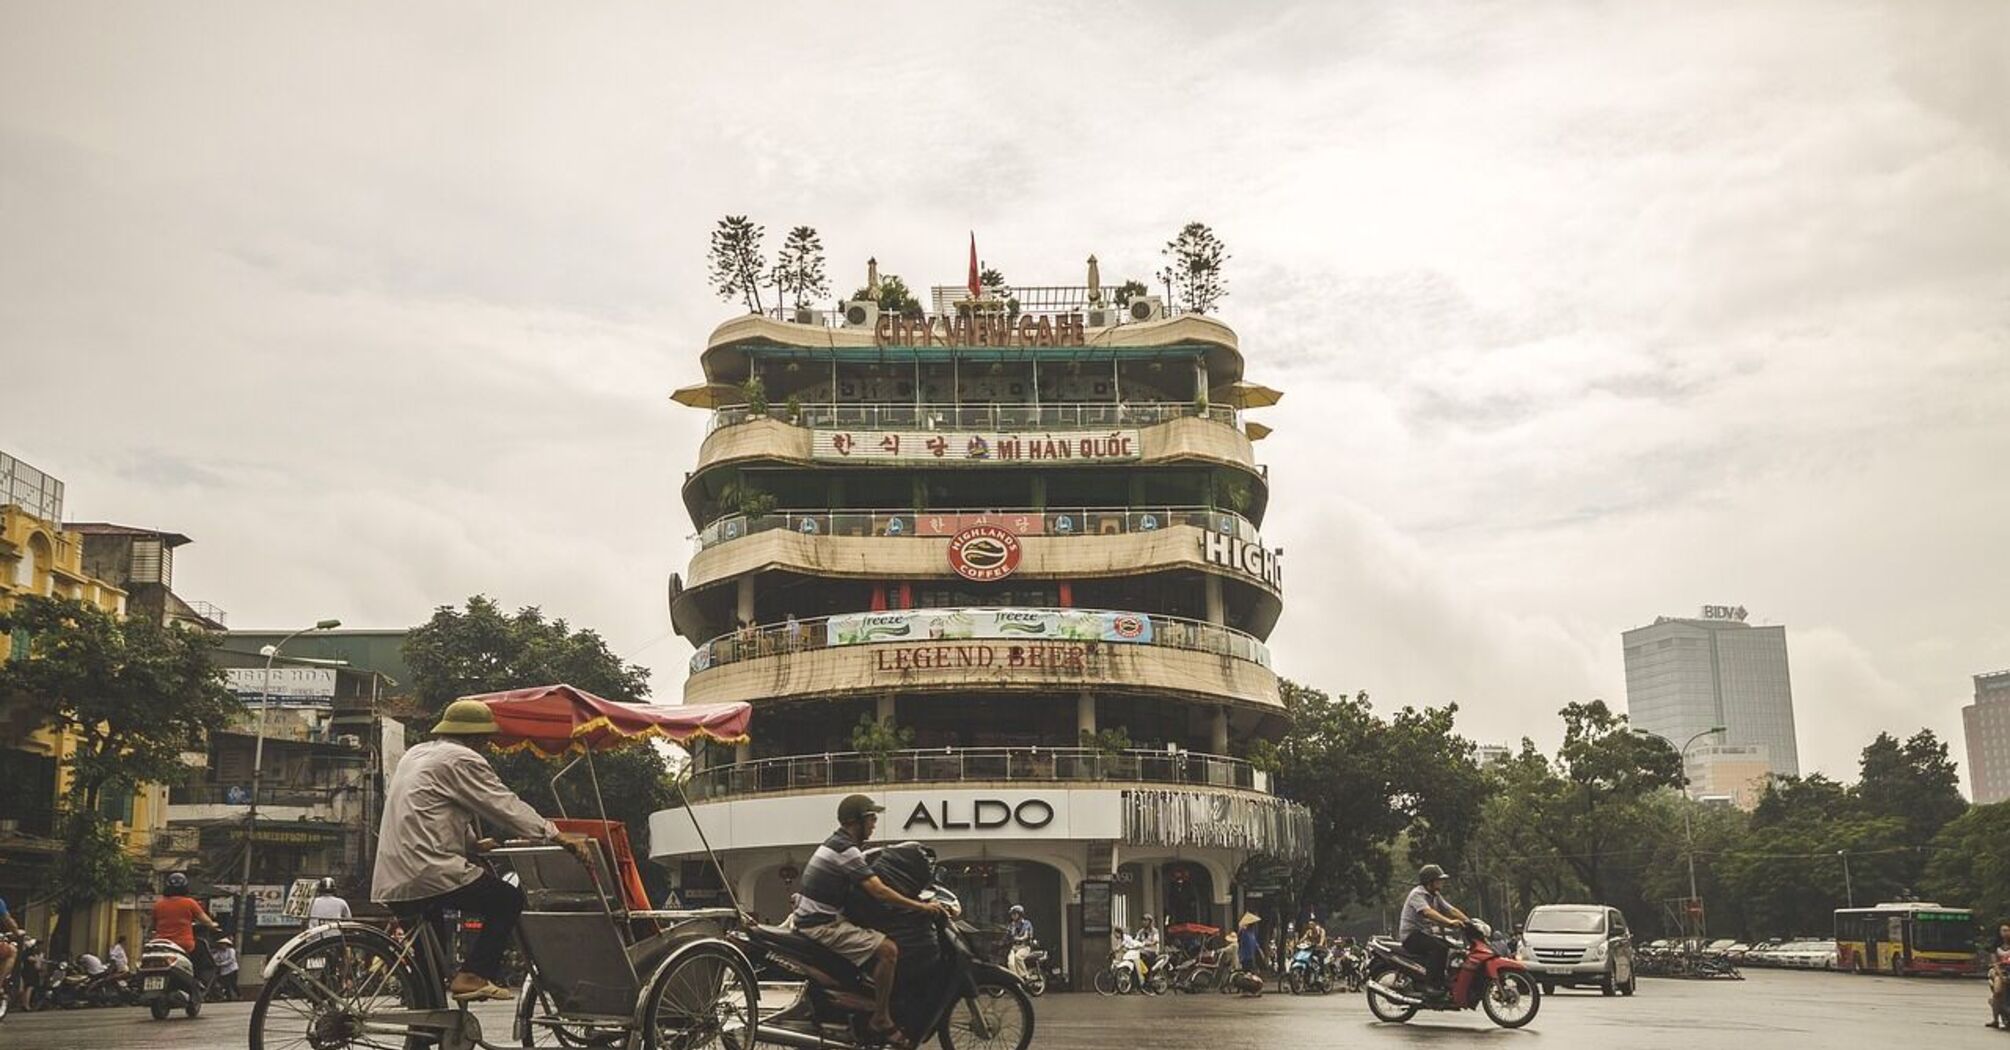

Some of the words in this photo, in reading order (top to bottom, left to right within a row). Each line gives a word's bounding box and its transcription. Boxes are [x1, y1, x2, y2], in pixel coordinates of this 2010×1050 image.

[875, 314, 936, 346] CITY
[943, 313, 1014, 346] VIEW
[997, 437, 1021, 459] MÌ
[1029, 433, 1072, 459] HÀN
[1080, 431, 1133, 458] QUỐC
[951, 529, 1018, 551] HIGHLANDS
[960, 564, 1011, 578] COFFEE
[861, 614, 905, 628] freeze
[994, 610, 1039, 624] freeze
[1704, 605, 1735, 619] BIDV
[878, 645, 994, 671] LEGEND
[903, 799, 1054, 830] ALDO
